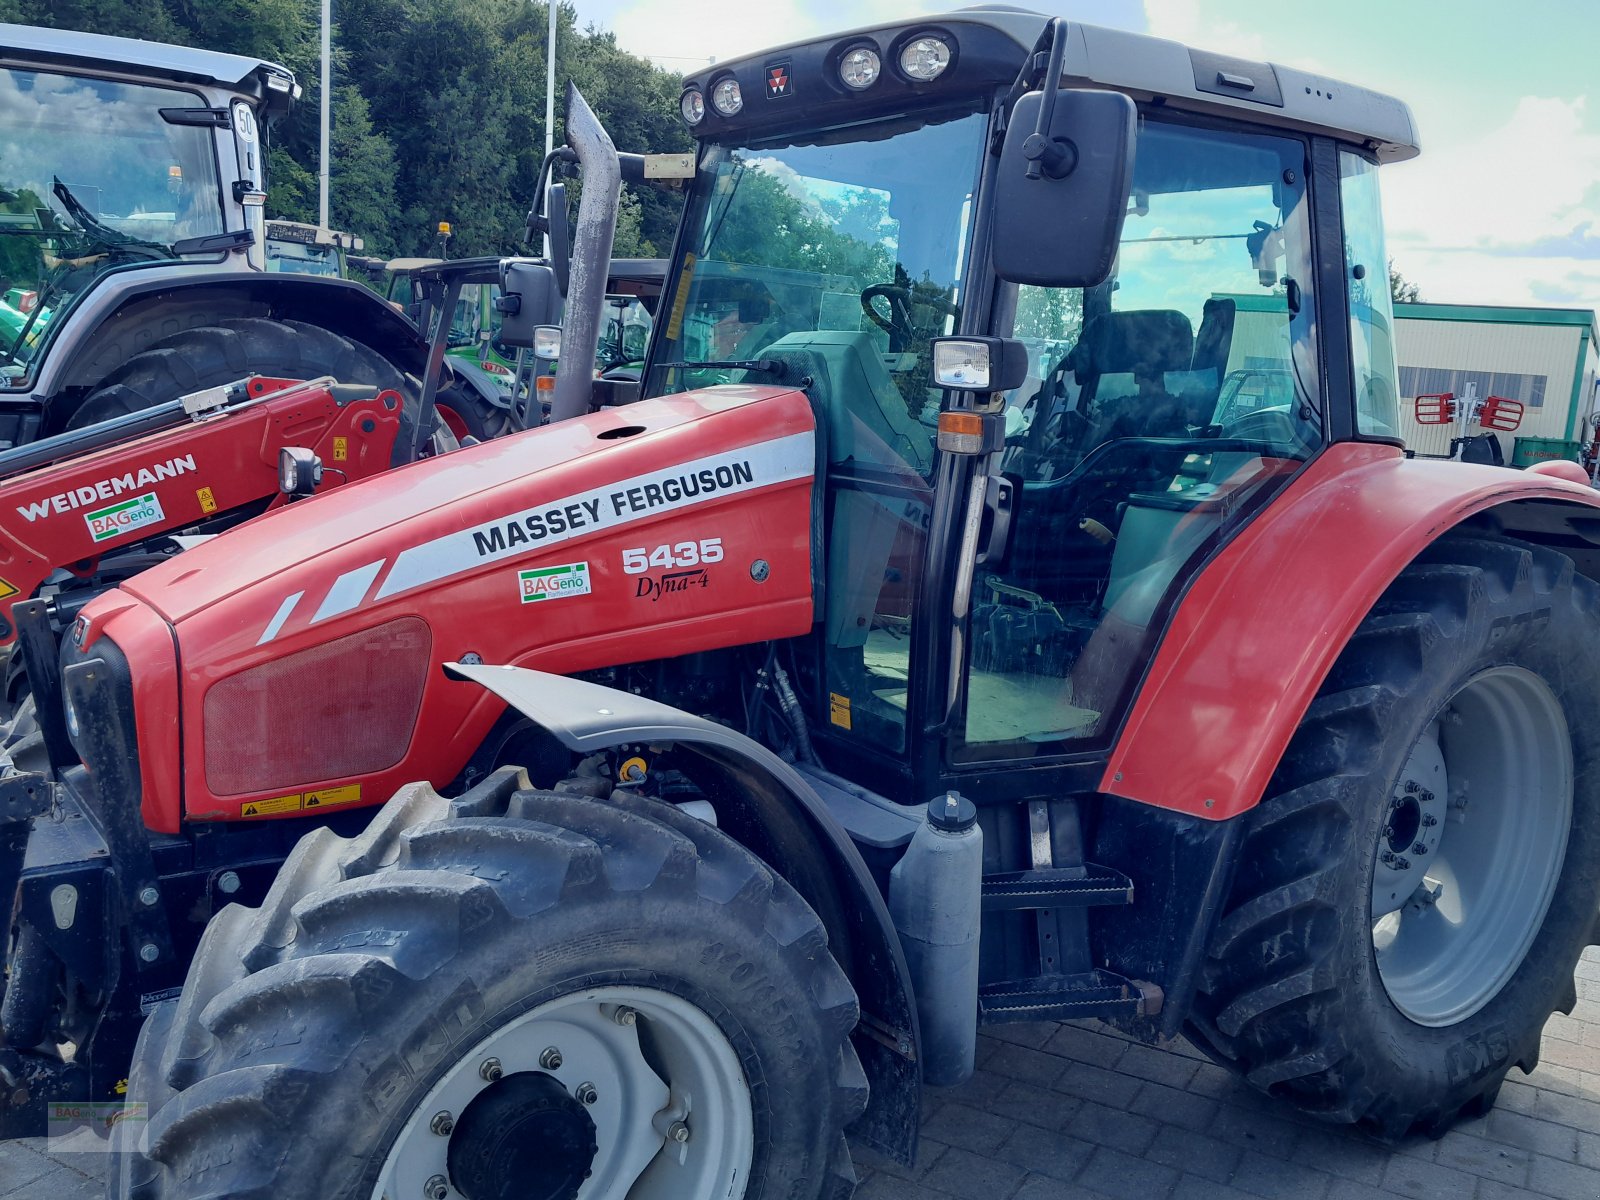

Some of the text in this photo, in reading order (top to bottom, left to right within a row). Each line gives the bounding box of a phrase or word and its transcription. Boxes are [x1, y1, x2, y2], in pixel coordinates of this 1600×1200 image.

[239, 109, 252, 135] 50
[16, 453, 197, 523] WEIDEMANN
[91, 507, 156, 534] BAGeno
[472, 460, 754, 556] MASSEY FERGUSON
[622, 538, 724, 575] 5435
[523, 575, 584, 595] BAGeno
[635, 567, 710, 601] Dyna-4
